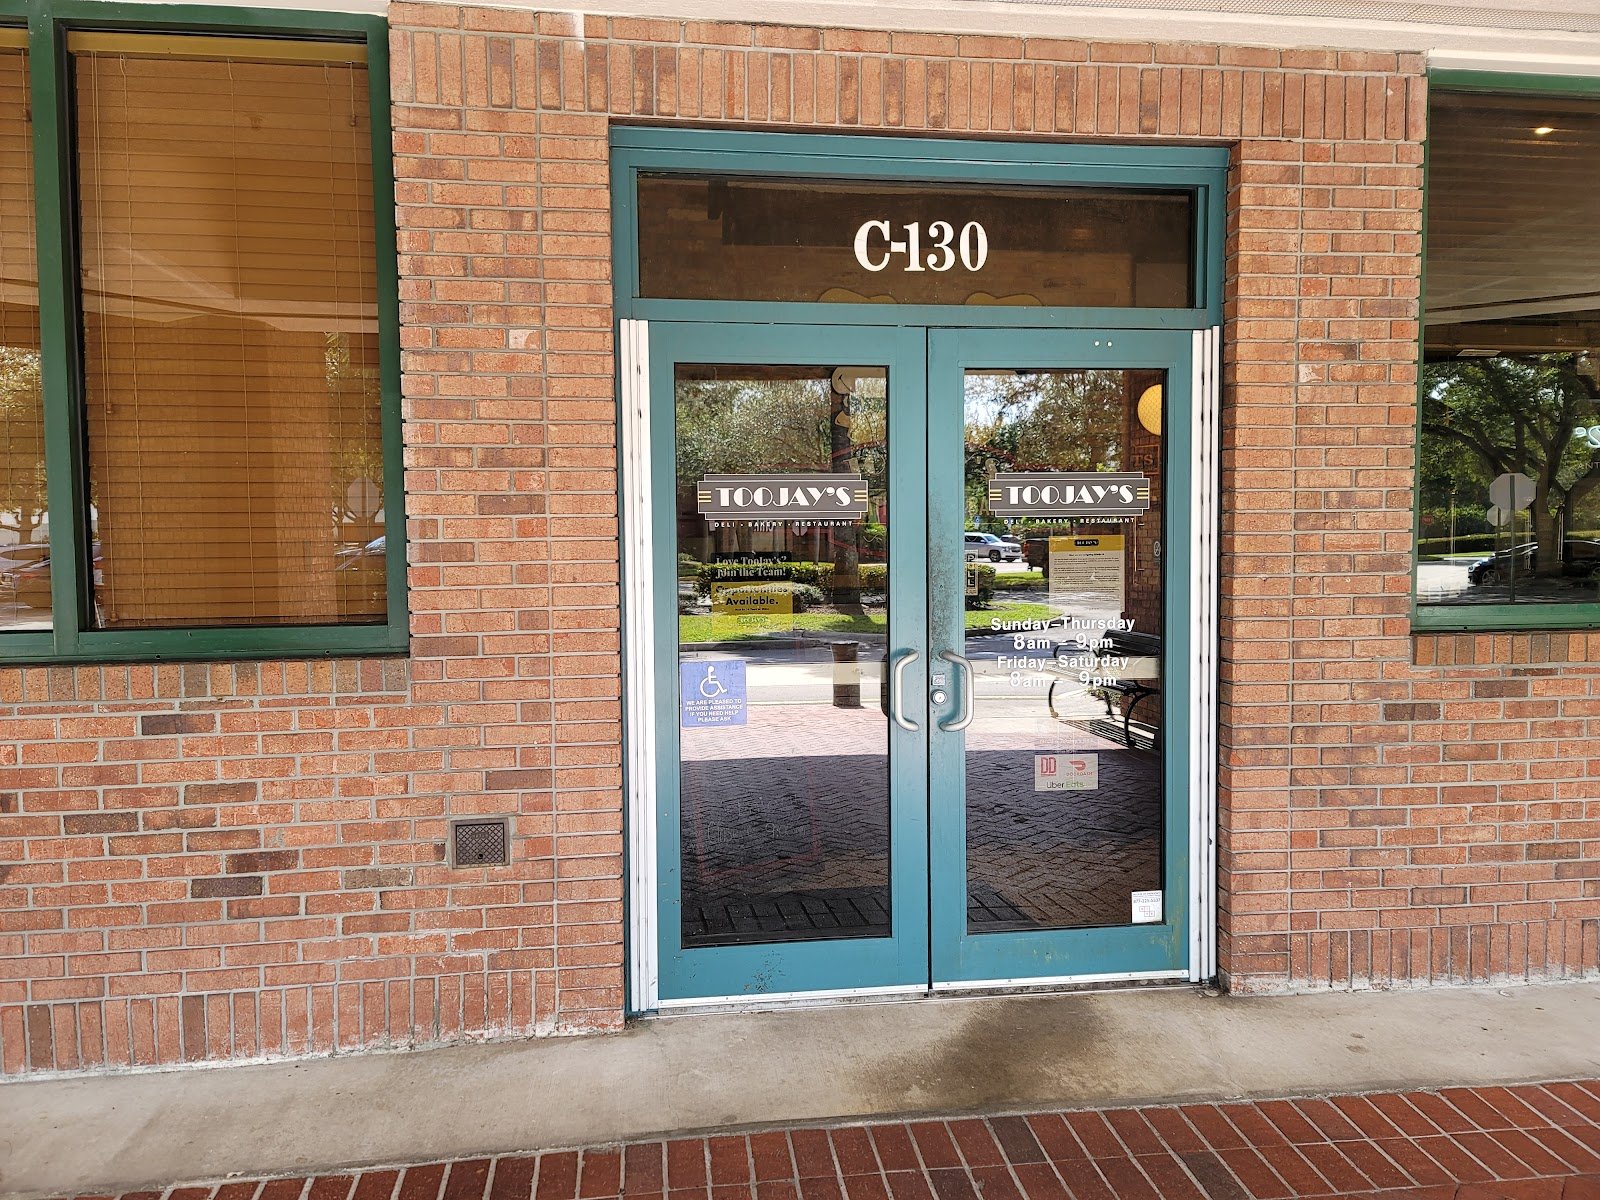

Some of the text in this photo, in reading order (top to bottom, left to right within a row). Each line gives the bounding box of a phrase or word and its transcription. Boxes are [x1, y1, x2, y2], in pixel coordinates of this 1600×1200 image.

[854, 220, 988, 272] C-130
[715, 486, 851, 507] TOOJAY'S
[1005, 484, 1134, 505] TOOJAY'S
[715, 567, 787, 579] Join the Team!
[967, 554, 975, 586] PLL
[725, 595, 779, 606] Available.
[1013, 633, 1050, 650] 8am
[1075, 633, 1114, 651] 9pm
[1079, 671, 1118, 690] 9pm
[1046, 781, 1065, 789] Uber
